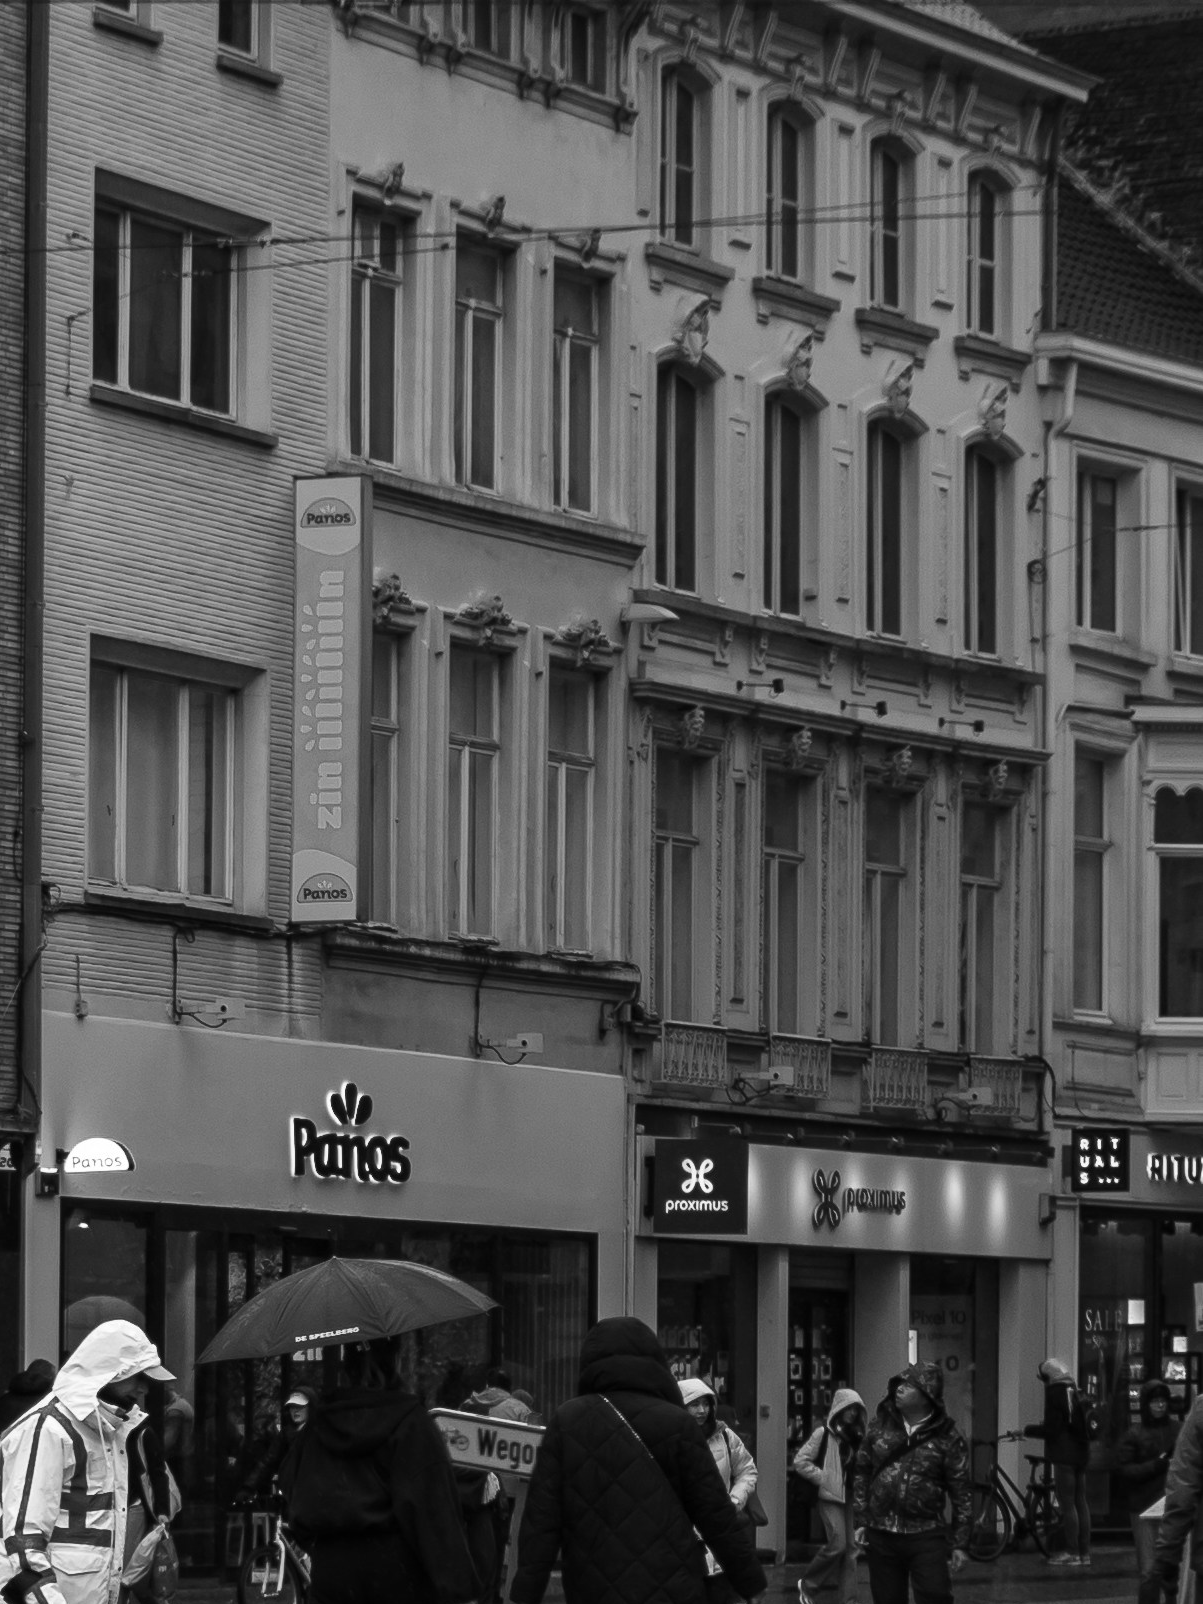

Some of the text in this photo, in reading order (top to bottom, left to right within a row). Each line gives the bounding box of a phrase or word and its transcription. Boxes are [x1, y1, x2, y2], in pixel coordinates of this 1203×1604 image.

[306, 512, 351, 526] Panos
[303, 886, 348, 901] Panos
[291, 1117, 411, 1183] Panos
[72, 1156, 123, 1169] Panos
[1146, 1153, 1203, 1185] RITU
[665, 1199, 729, 1214] proximus
[846, 1188, 906, 1213] proximus
[912, 1310, 967, 1325] Pixel 10
[1084, 1308, 1123, 1332] SALE
[478, 1426, 534, 1470] Wego
